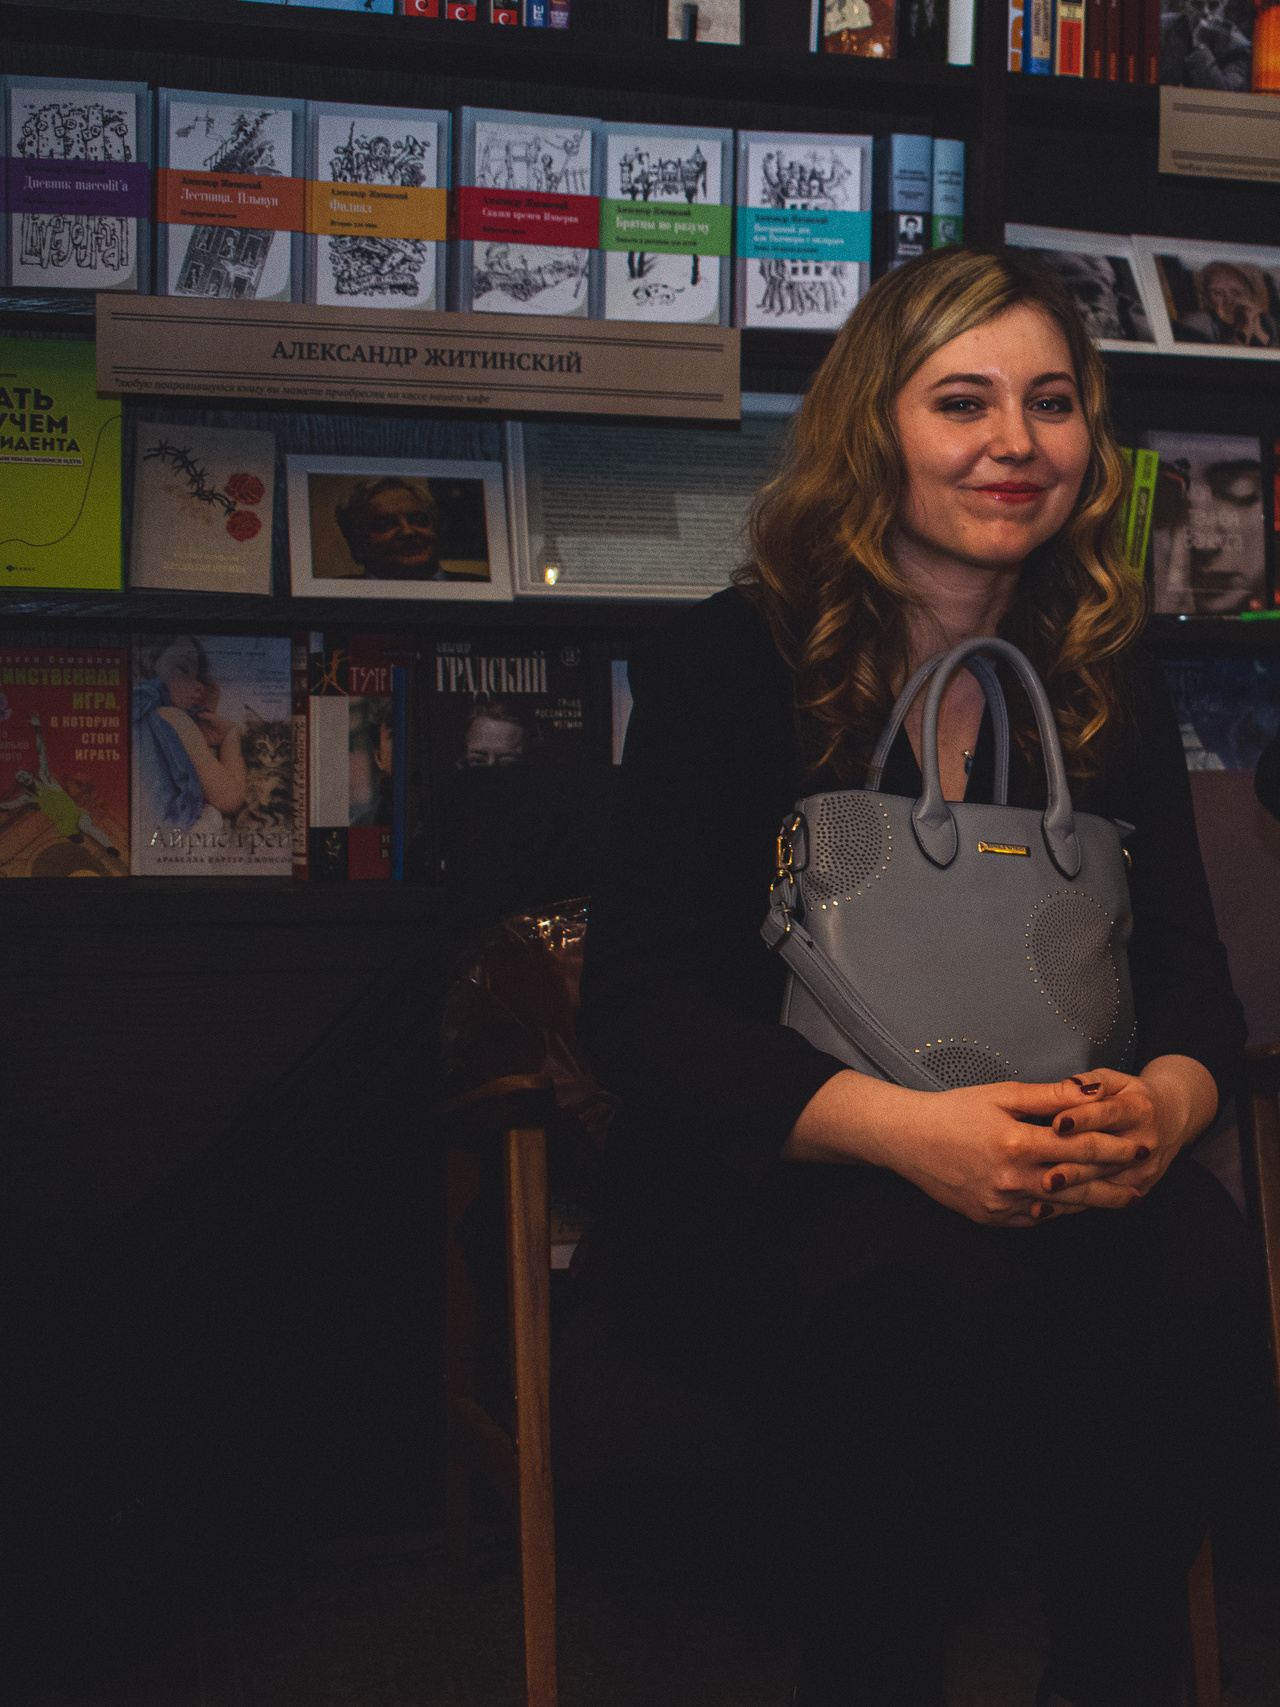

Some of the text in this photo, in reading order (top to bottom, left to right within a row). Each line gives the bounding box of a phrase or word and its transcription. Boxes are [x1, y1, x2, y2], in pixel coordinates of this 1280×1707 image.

[23, 175, 72, 191] Дневник
[271, 340, 582, 373] АЛЕКСАНДР ЖИТИНСКИЙ
[0, 387, 54, 410] АТЬ
[0, 435, 80, 453] ИДЕНТА
[436, 650, 548, 703] ГРАДСКИЙ
[49, 714, 121, 729] В КОТОРУЮ
[81, 731, 120, 745] СТОИТ
[74, 748, 121, 761] ИГРАТЬ
